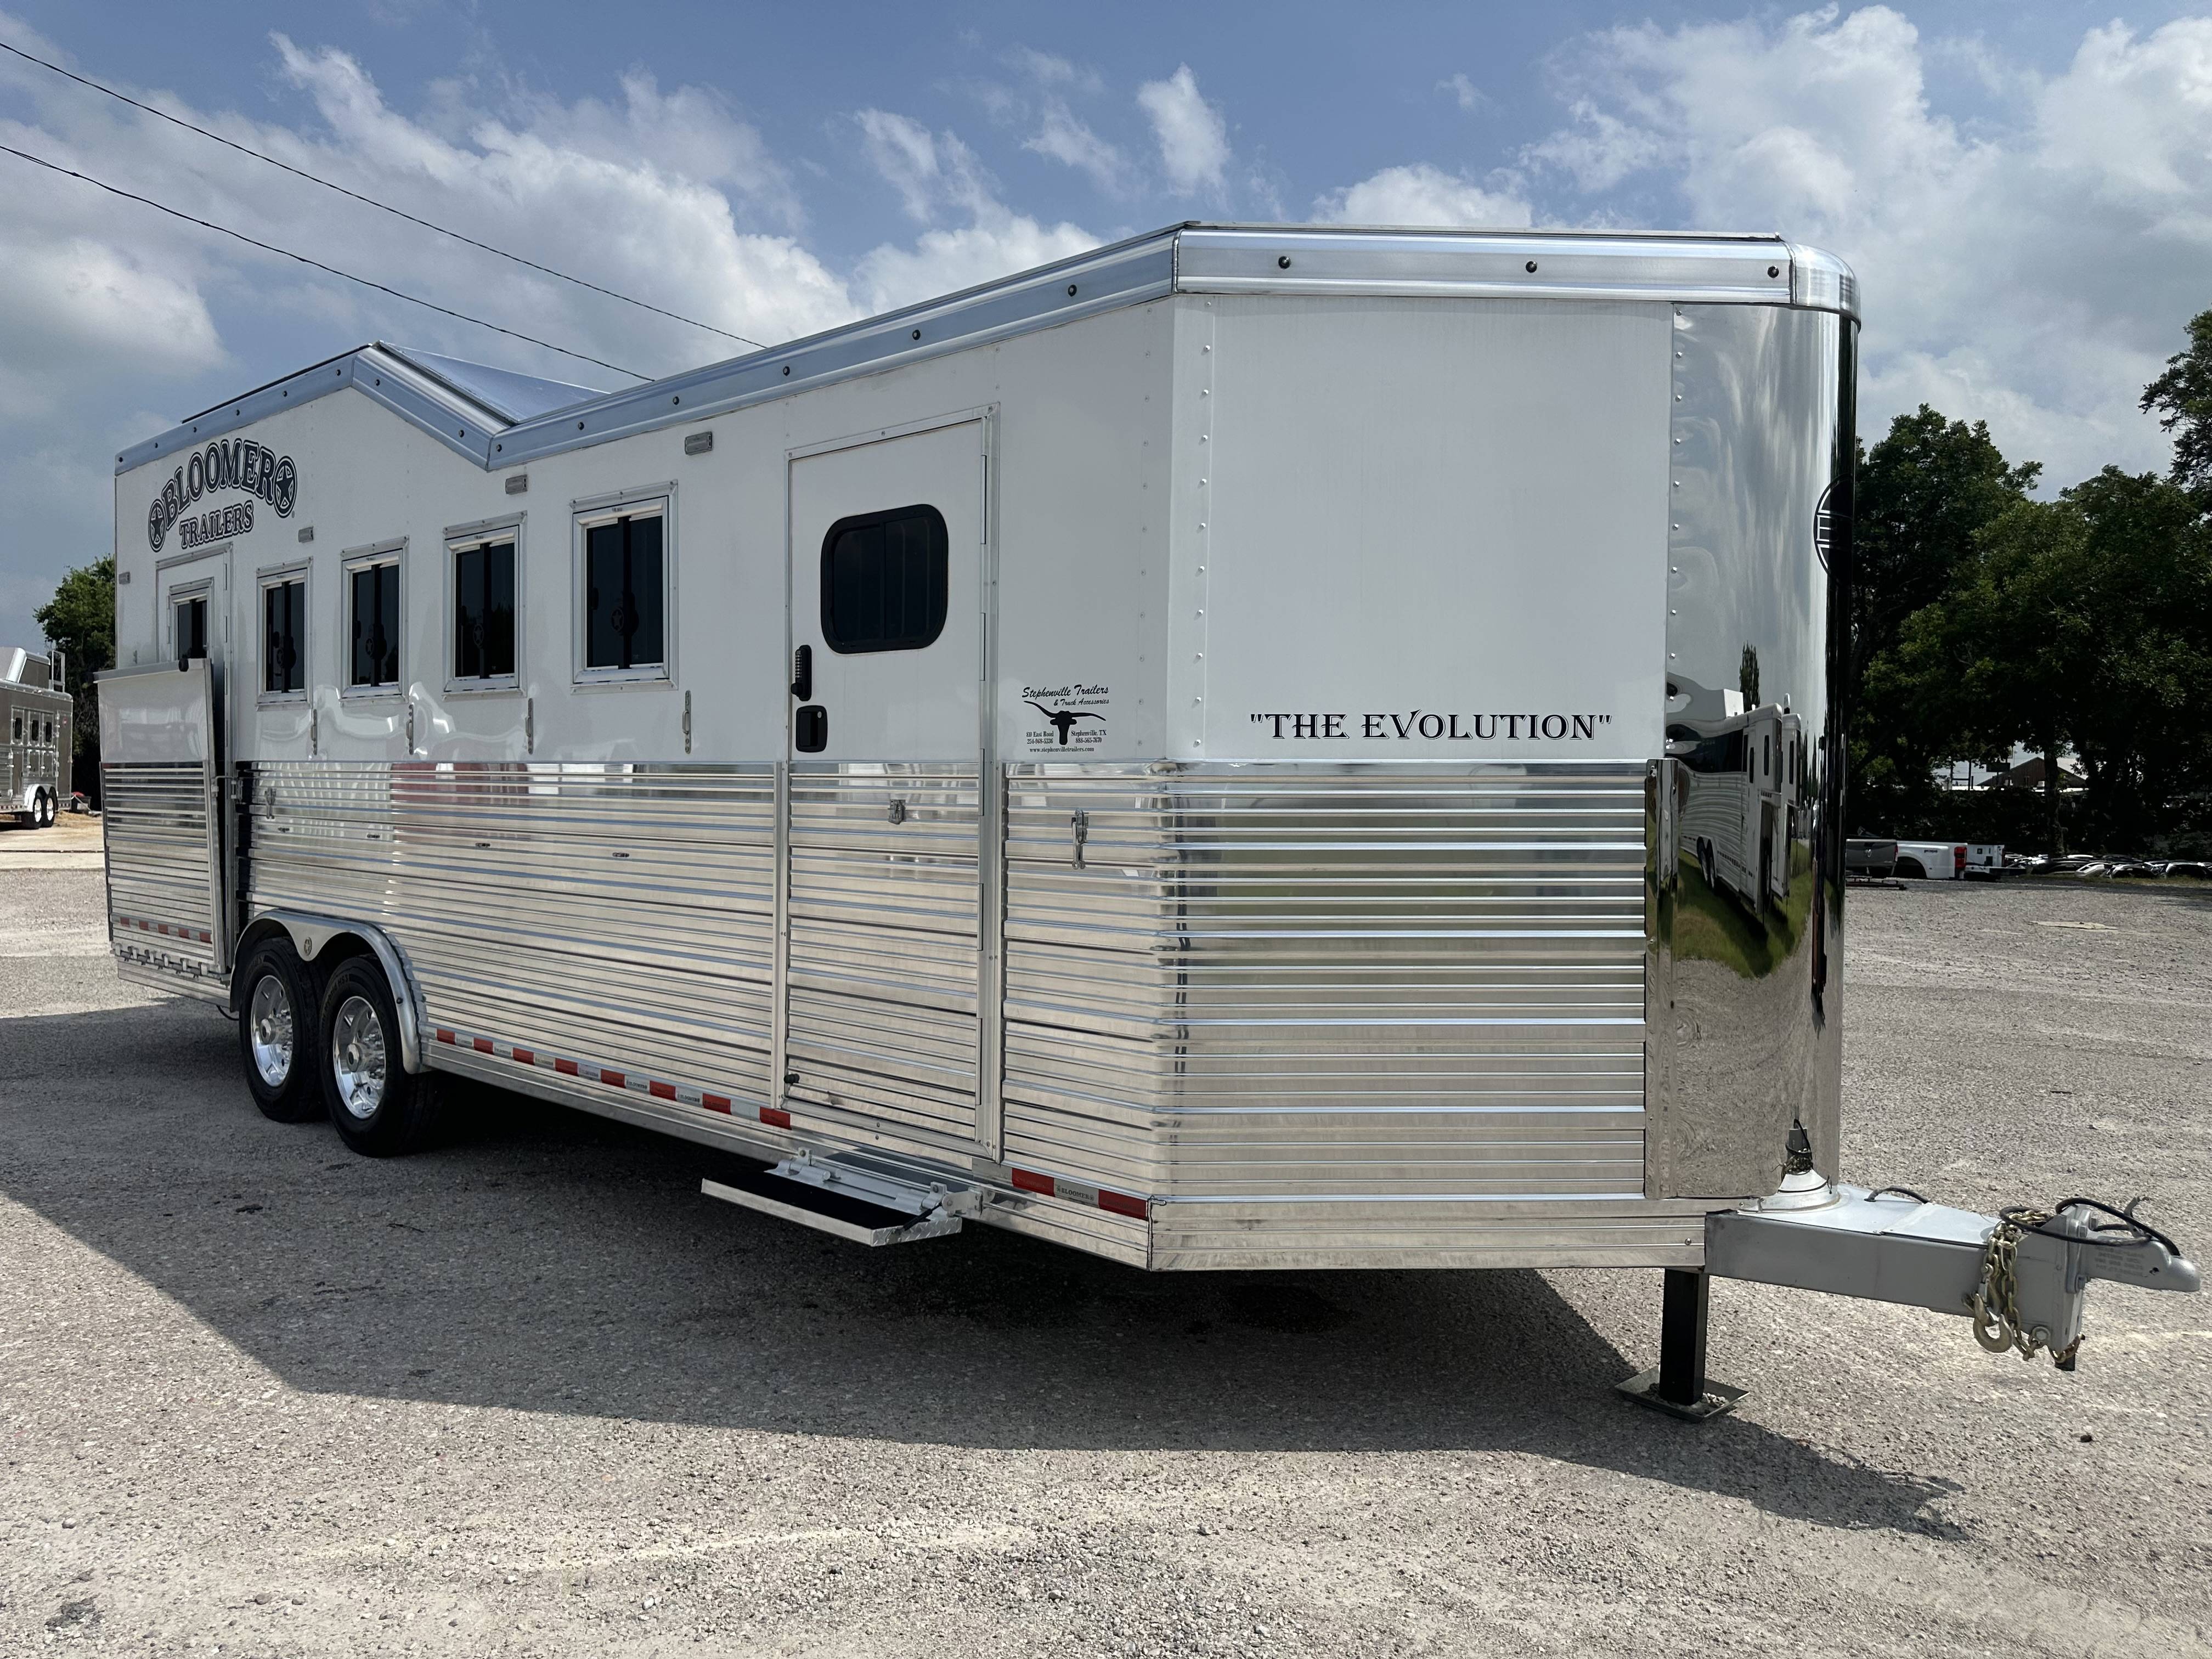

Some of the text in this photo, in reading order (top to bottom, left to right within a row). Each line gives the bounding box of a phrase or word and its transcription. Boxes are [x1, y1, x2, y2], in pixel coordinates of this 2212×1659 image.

[162, 438, 276, 531] BLOOMER
[179, 500, 254, 549] TRAILERS
[1022, 684, 1109, 700] Stephenville Trailers
[1077, 697, 1110, 706] Accessories
[1250, 709, 1612, 740] "THE EVOLUTION"
[1061, 1187, 1090, 1200] BLOOMER
